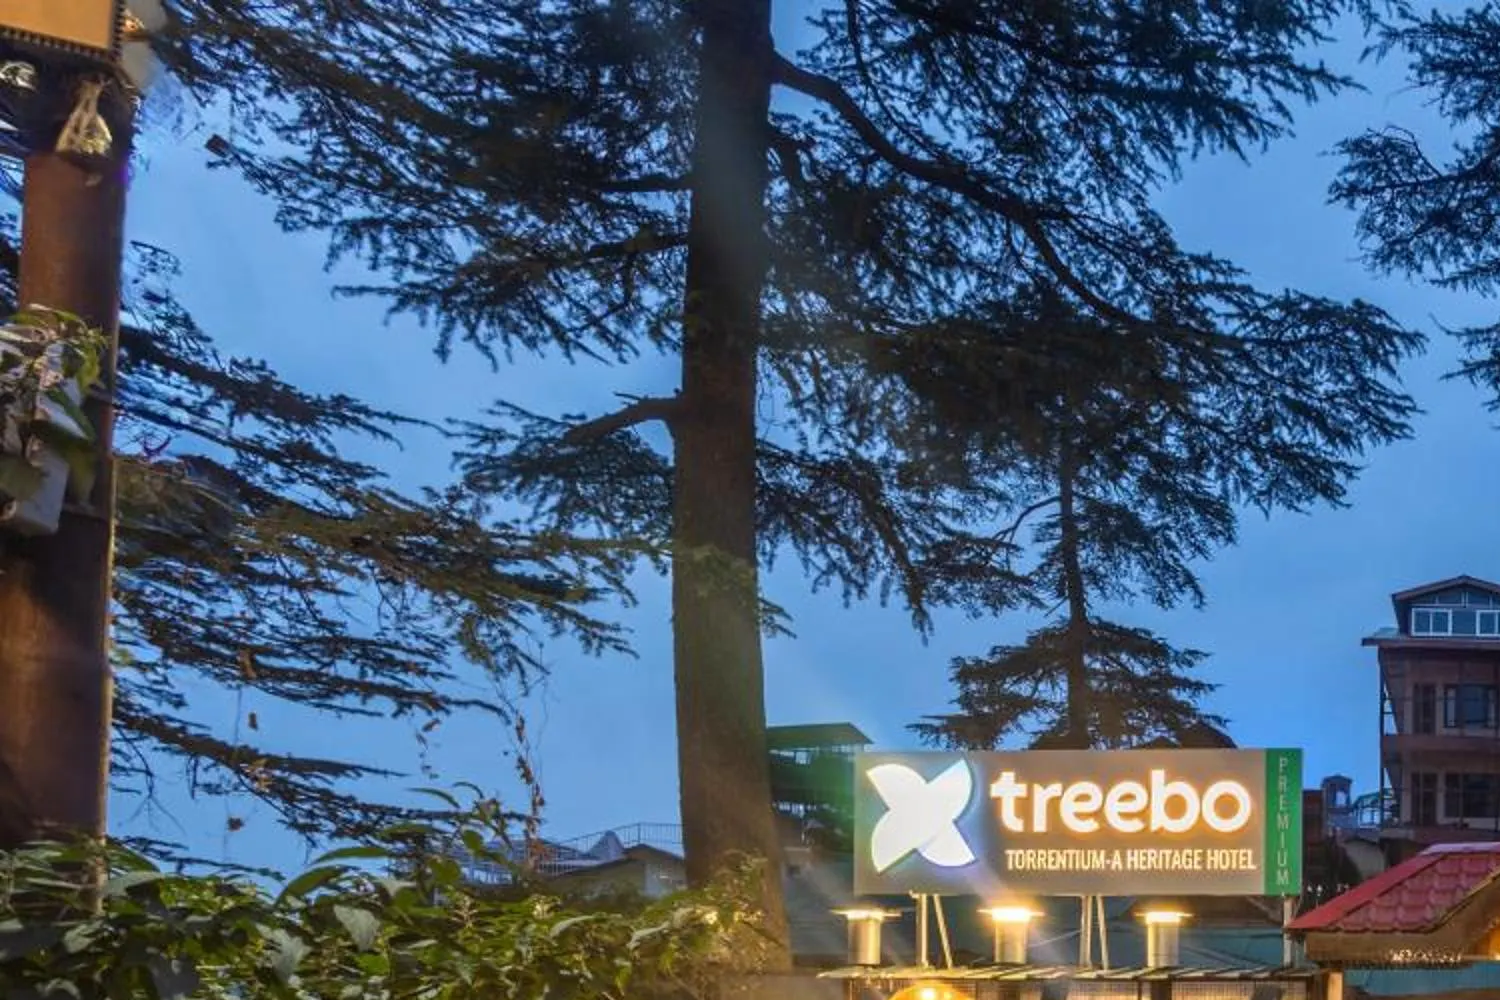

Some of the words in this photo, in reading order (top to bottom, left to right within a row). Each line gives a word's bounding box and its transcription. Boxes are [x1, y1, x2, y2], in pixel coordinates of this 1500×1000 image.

[990, 769, 1252, 833] treebo
[1276, 757, 1290, 886] PREMIUM
[1126, 848, 1203, 871] HERITAGE
[1206, 848, 1257, 871] HOTEL
